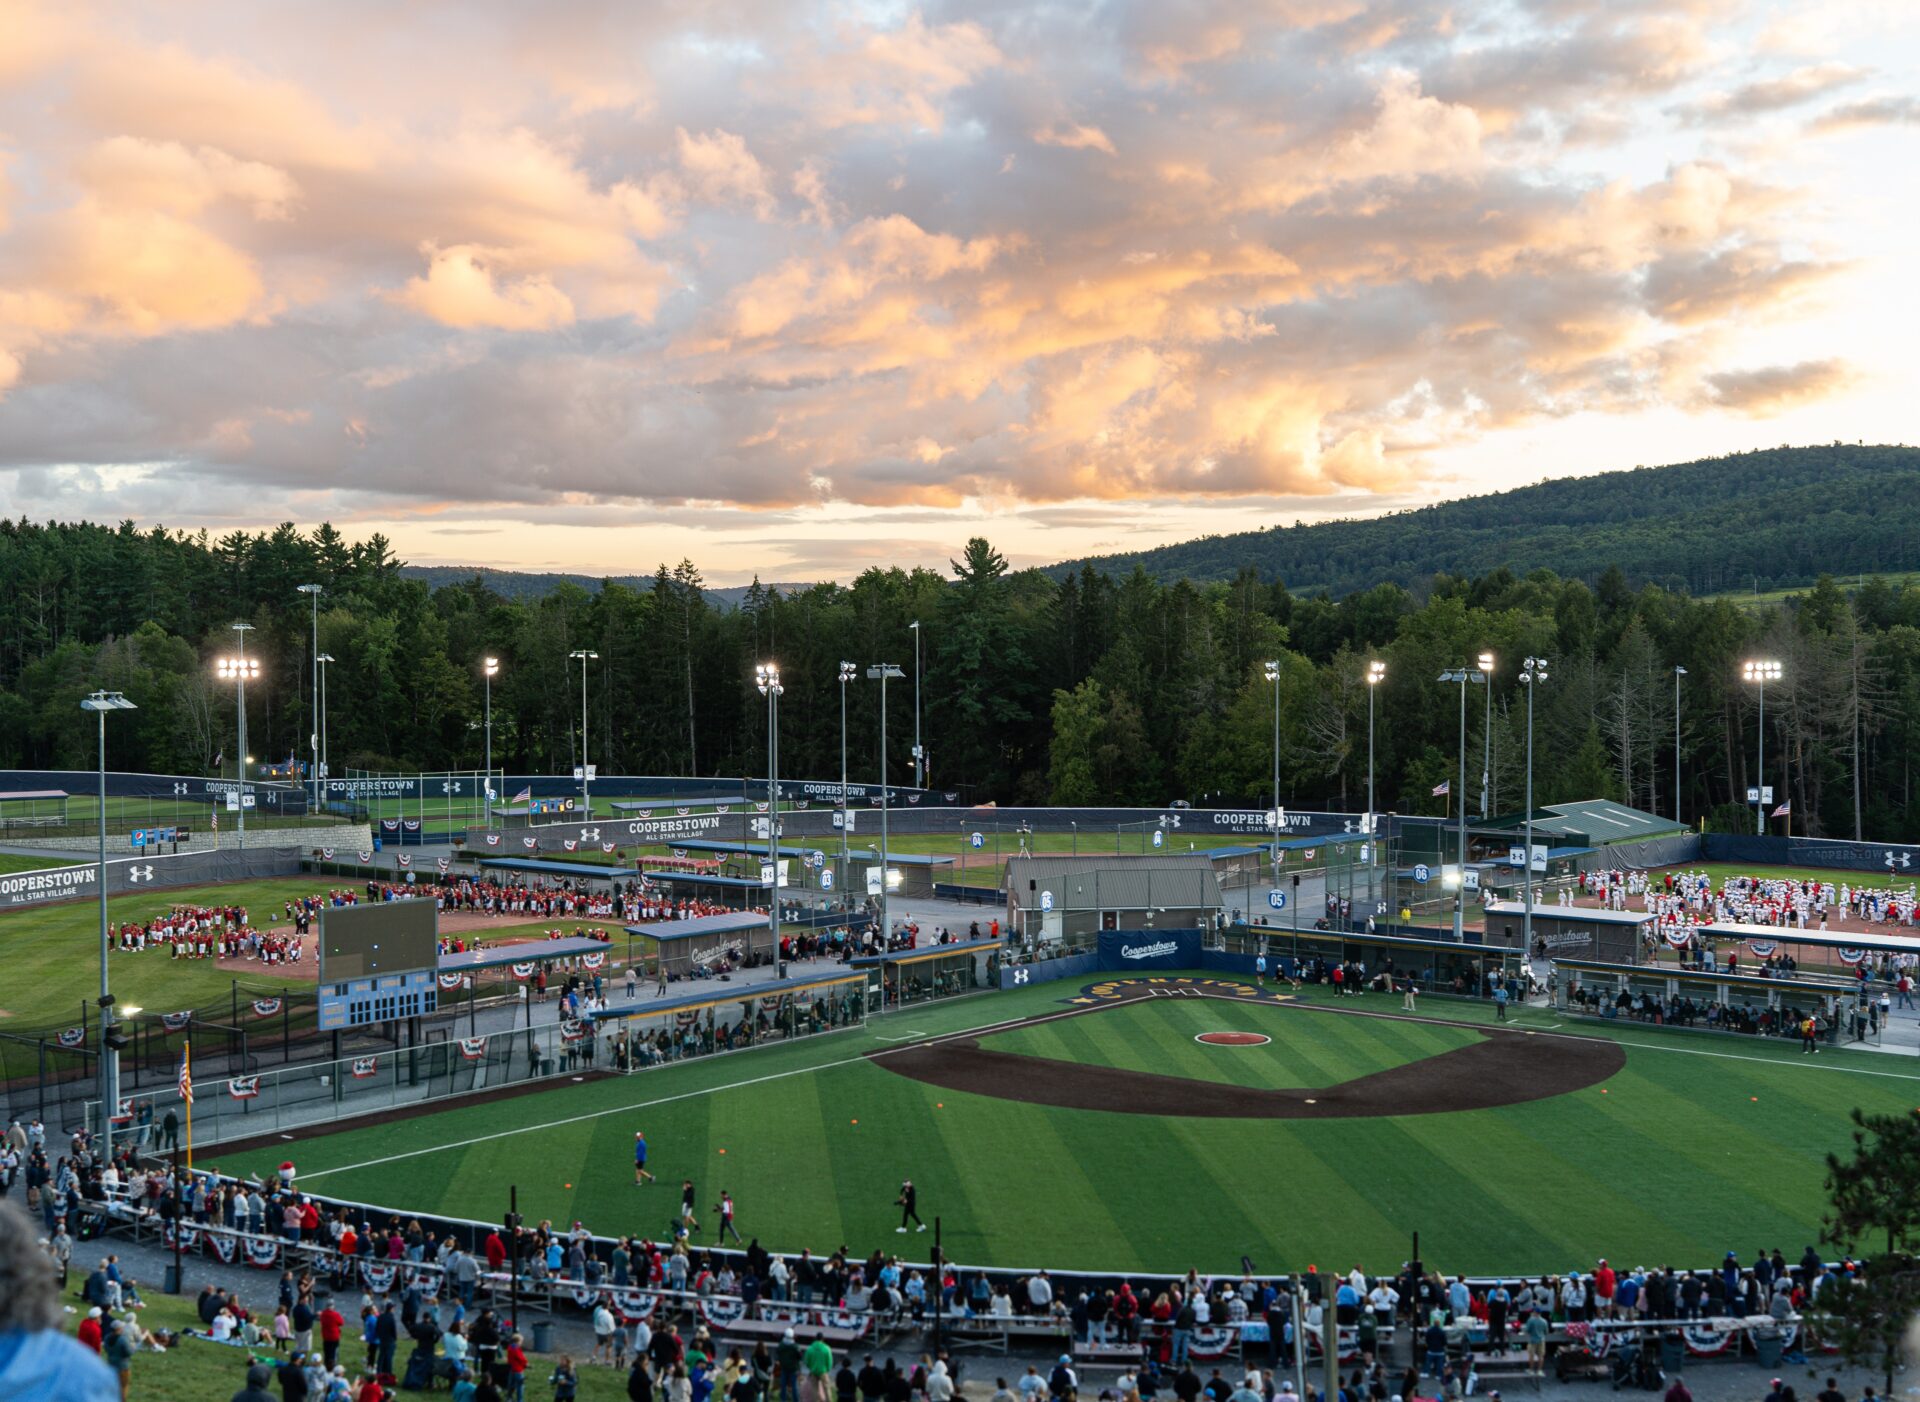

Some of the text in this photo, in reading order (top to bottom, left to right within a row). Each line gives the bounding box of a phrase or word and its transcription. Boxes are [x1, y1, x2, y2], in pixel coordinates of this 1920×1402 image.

[331, 781, 414, 791] COOPERSTOWN
[629, 817, 720, 833] COOPERSTOWN
[1214, 814, 1311, 826] COOPERSOWN
[659, 832, 676, 840] STAR
[677, 830, 704, 839] VILLAGE
[814, 855, 823, 866] 03
[822, 875, 832, 886] 03
[1416, 869, 1427, 880] 06
[0, 869, 96, 894] OOPERSTOWN
[12, 887, 77, 903] ALL STAR VILLAGE
[1271, 894, 1283, 906] 05
[1042, 895, 1051, 908] 05
[1121, 941, 1176, 957] Cooperstown
